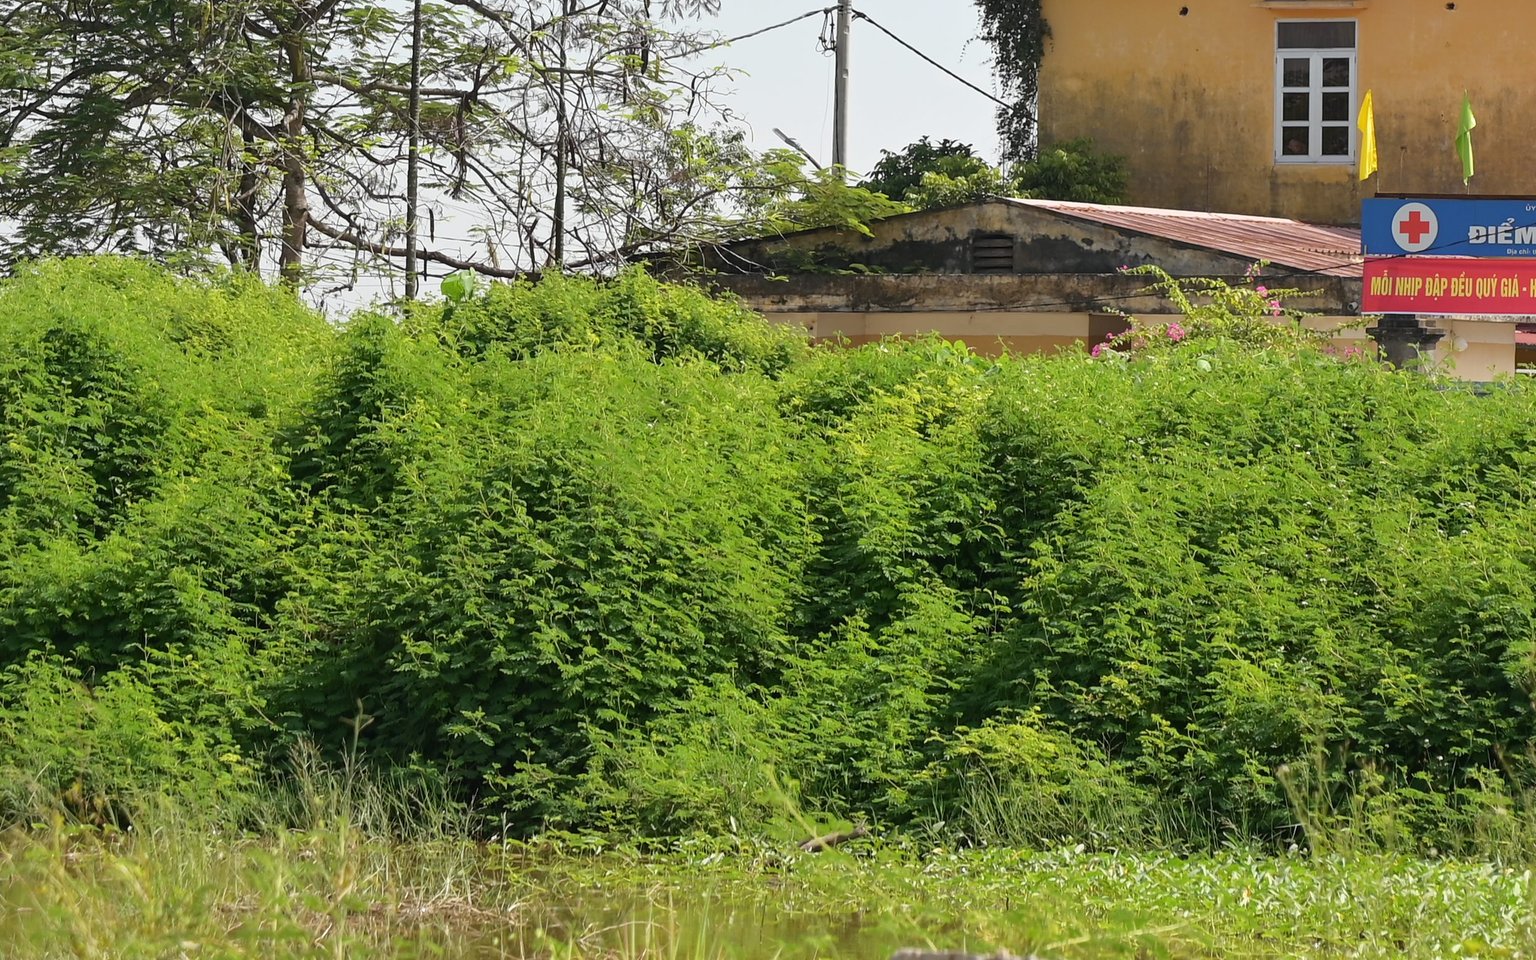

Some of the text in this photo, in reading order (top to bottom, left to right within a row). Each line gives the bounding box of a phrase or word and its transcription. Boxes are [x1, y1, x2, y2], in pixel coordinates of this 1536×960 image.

[1370, 269, 1393, 296] MỖI
[1394, 277, 1422, 301] NHỊP
[1425, 273, 1448, 301] ĐẬP
[1451, 271, 1473, 297] ĐỀU
[1475, 273, 1498, 299] QUÝ
[1500, 273, 1519, 297] GIÁ
